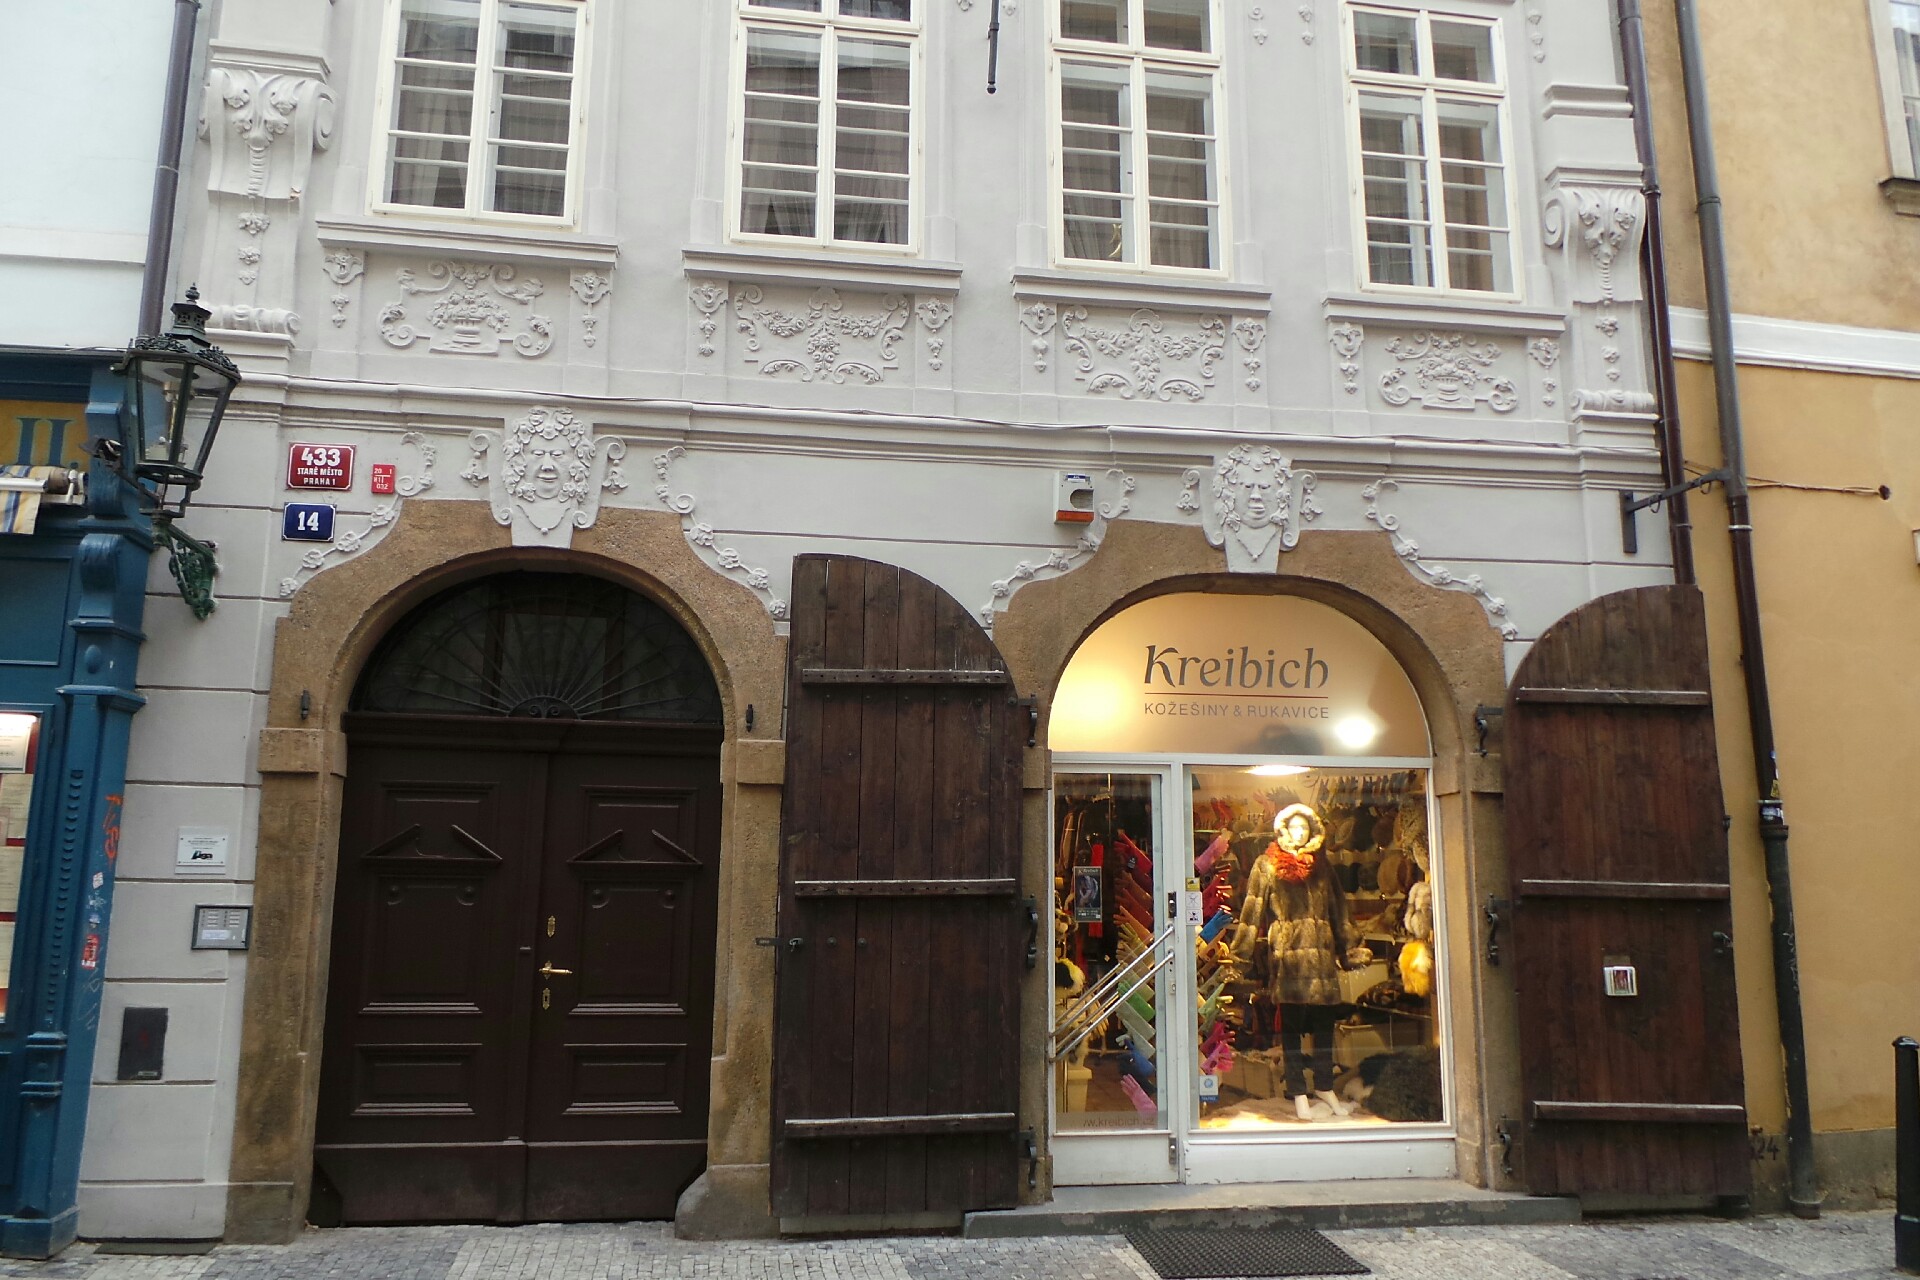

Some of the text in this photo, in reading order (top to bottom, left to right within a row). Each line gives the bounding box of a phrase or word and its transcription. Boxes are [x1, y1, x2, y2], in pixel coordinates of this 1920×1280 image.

[301, 447, 341, 467] 433
[297, 466, 343, 476] STARÉ MĚSTO
[374, 467, 383, 475] 20
[303, 477, 336, 486] PRAHA 1
[297, 511, 319, 531] 14
[1144, 645, 1329, 689] Kreibich
[1144, 701, 1329, 719] KOŽEŠINY & RUKAVICE
